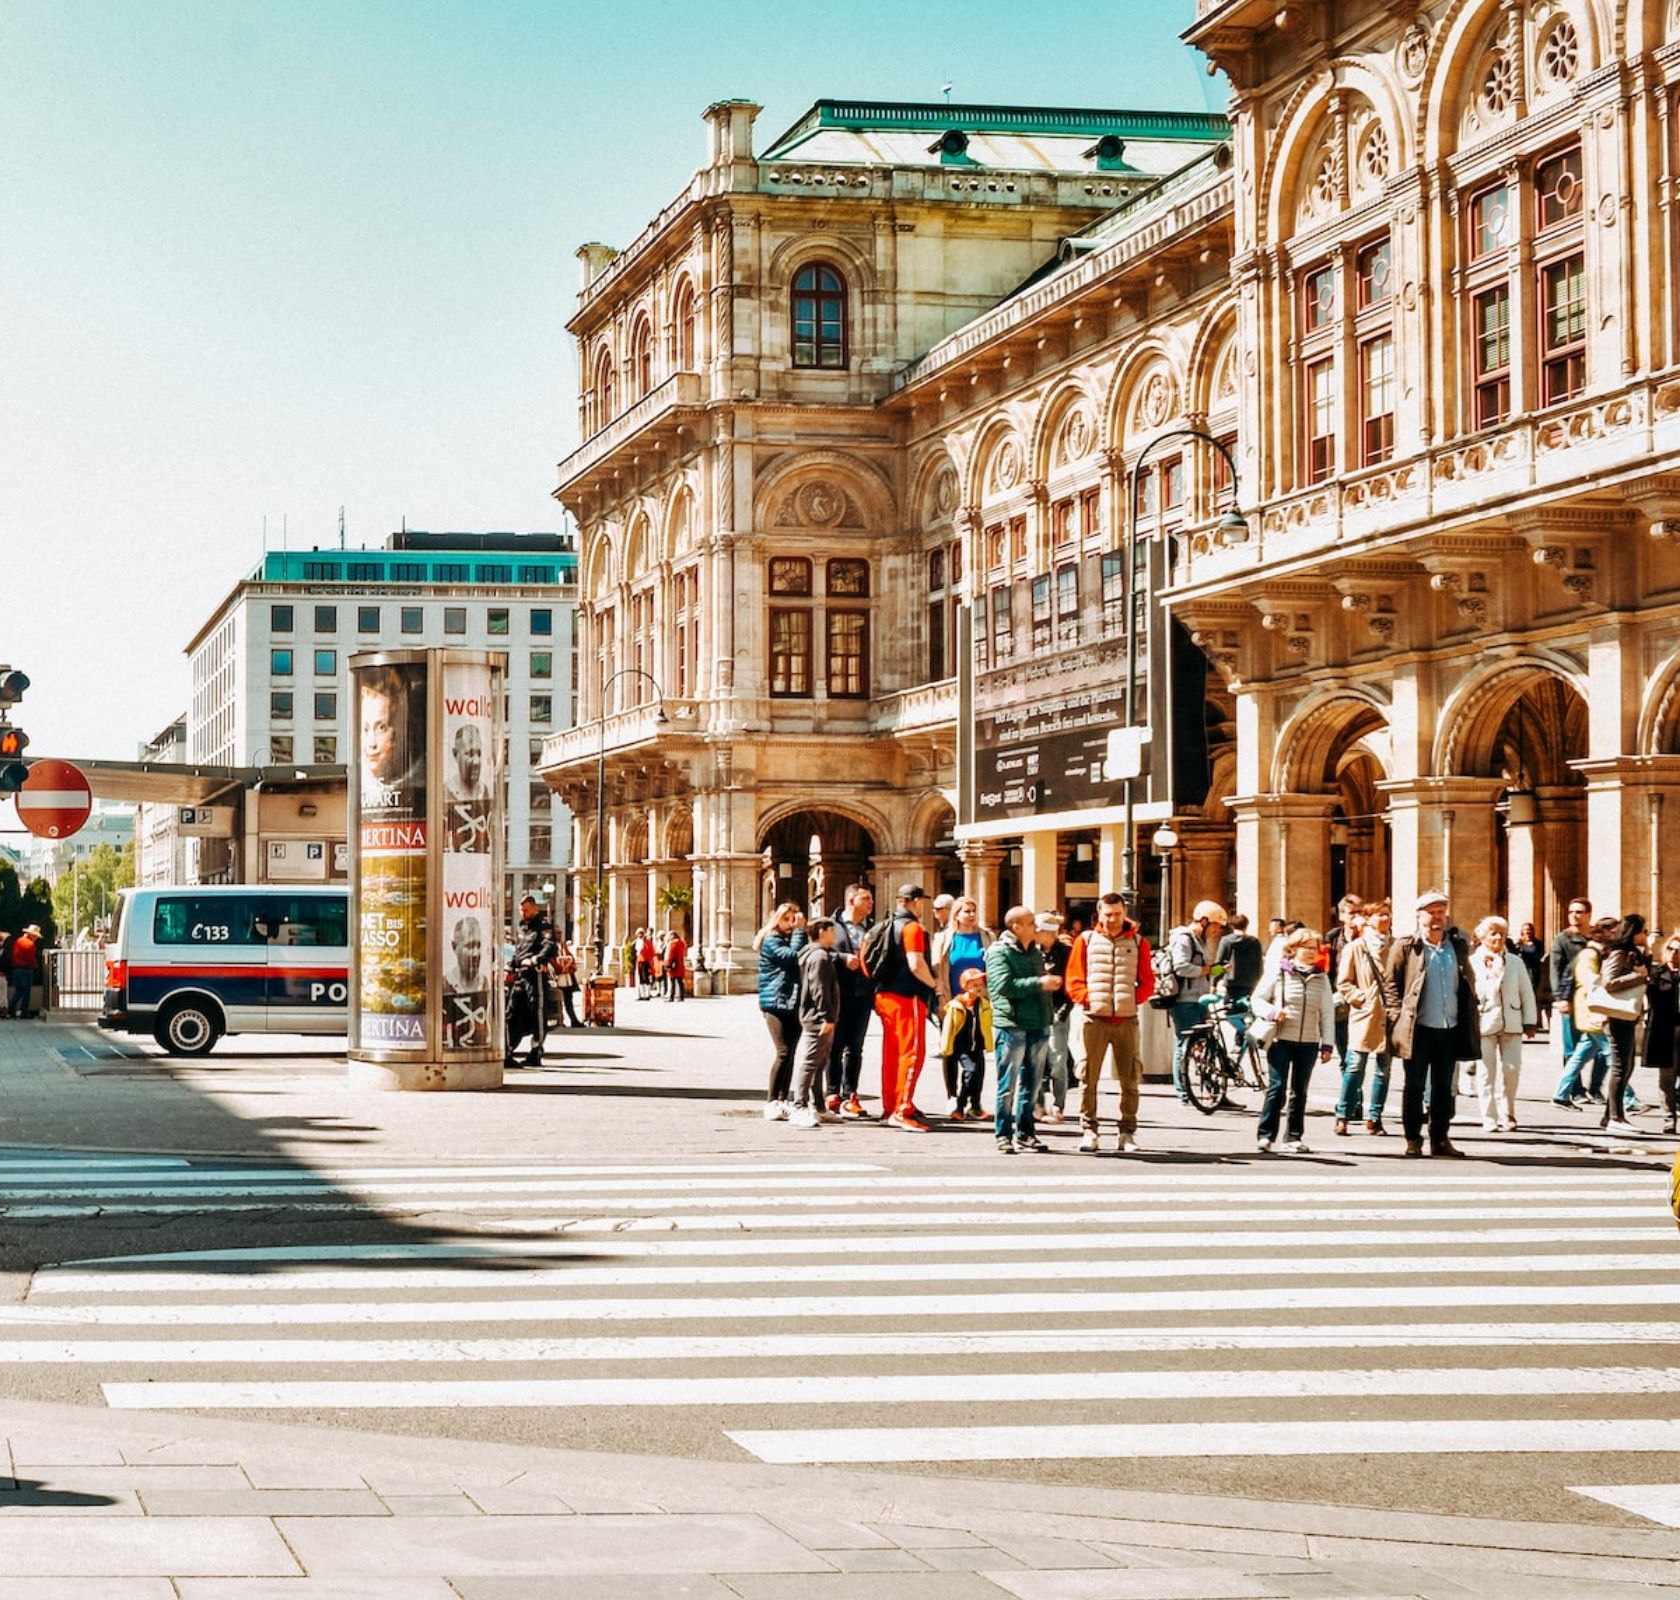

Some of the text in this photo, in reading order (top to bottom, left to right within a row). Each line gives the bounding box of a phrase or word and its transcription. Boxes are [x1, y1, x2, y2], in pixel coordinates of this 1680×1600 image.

[182, 811, 193, 822] P
[309, 848, 320, 859] P
[361, 930, 399, 947] ASSO
[311, 983, 347, 1001] PO
